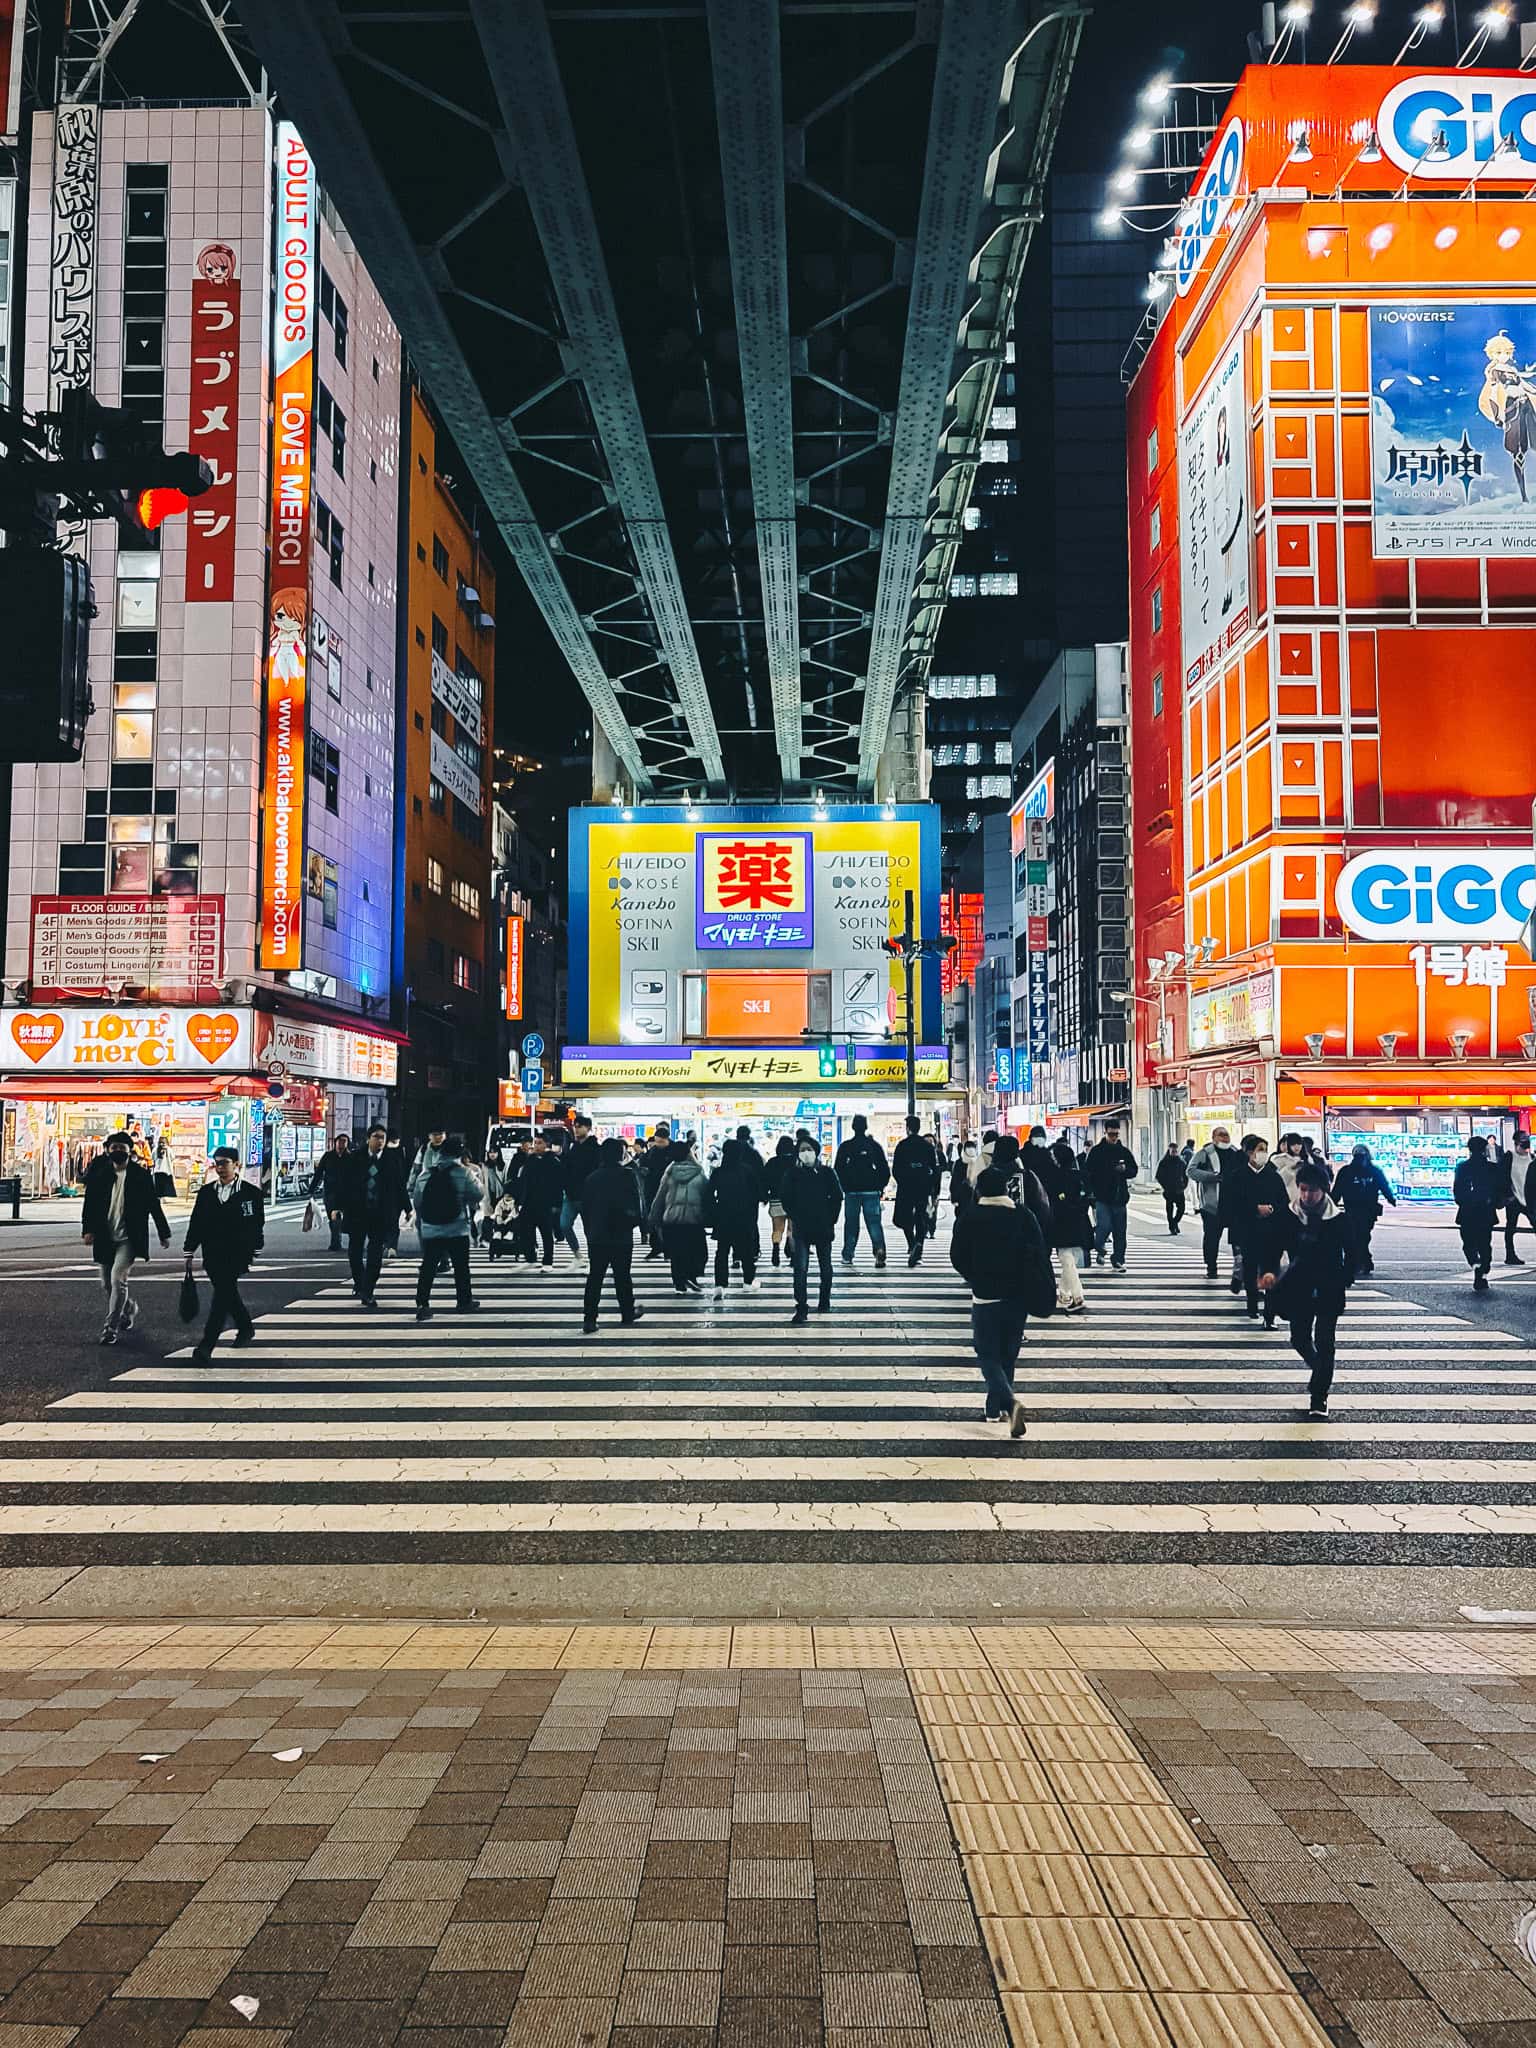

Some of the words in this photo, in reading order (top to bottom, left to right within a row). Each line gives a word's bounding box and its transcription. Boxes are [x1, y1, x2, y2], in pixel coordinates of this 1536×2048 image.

[284, 137, 308, 228] ADULT
[1179, 131, 1239, 286] GiGO
[283, 239, 307, 343] GOODS
[1379, 310, 1456, 324] HOYOVERSE
[282, 392, 306, 467] LOVE
[1384, 429, 1483, 505] 原神
[278, 472, 304, 566] MERCI
[1406, 538, 1444, 548] PS5
[1456, 538, 1493, 547] PS4
[273, 697, 293, 957] www.akibalovemerci.com
[601, 856, 687, 870] SHISEIDO
[823, 855, 911, 869] SHISEIDO
[635, 875, 680, 890] KOSÉ
[717, 841, 793, 910] 薬
[860, 874, 904, 889] KOSÉ
[71, 903, 104, 913] FLOOR
[107, 903, 137, 913] GUIDE
[610, 897, 677, 911] Kanebo
[834, 896, 901, 911] Kanebo
[42, 916, 58, 926] 4F
[66, 916, 94, 926] Men's
[95, 916, 127, 926] Goods
[615, 918, 673, 931] SOFINA
[727, 914, 752, 922] DRUG
[754, 914, 782, 922] STORE
[839, 917, 898, 930] SOFINA
[42, 931, 57, 941] 3F
[66, 931, 93, 940] Men's
[95, 931, 126, 941] Goods
[41, 946, 57, 956] 2F
[65, 946, 107, 956] Couple's
[108, 946, 140, 955] Goods
[42, 961, 57, 970] 1F
[65, 960, 109, 970] Costume
[1409, 946, 1507, 986] 1号館
[64, 975, 94, 985] Fetish
[581, 1066, 647, 1076] Matsumoto
[649, 1066, 692, 1076] KiYoshi
[1000, 1055, 1010, 1085] GiGO
